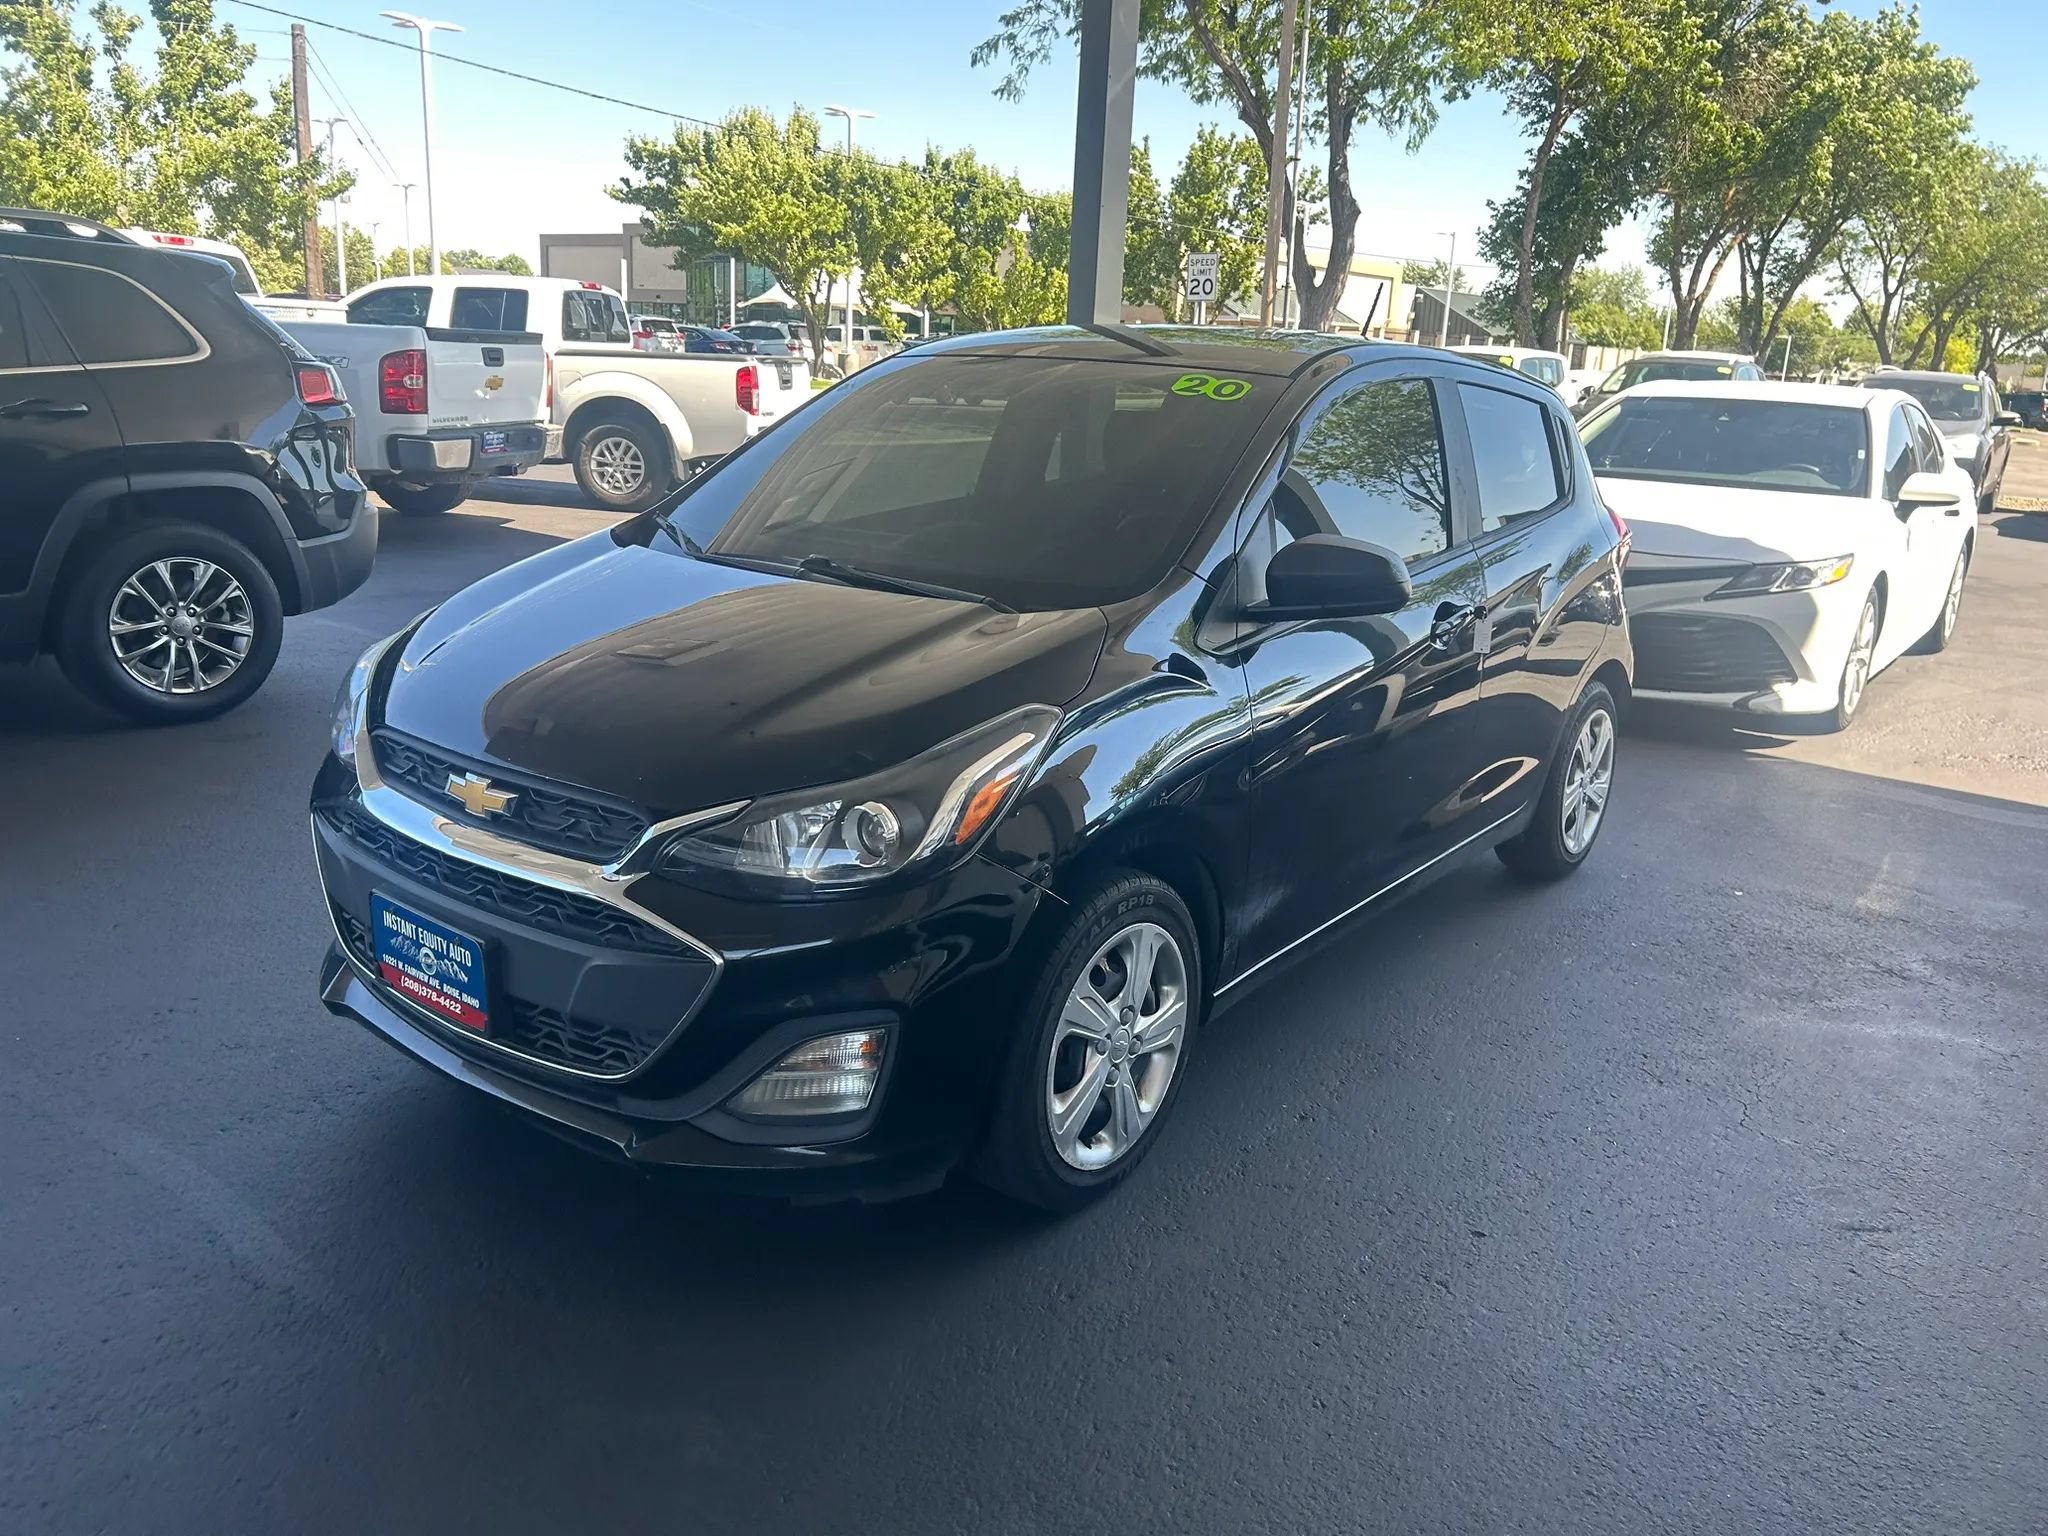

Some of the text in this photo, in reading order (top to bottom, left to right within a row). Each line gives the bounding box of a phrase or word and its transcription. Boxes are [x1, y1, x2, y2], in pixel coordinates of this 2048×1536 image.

[1190, 258, 1216, 267] SPEED
[1192, 268, 1212, 276] LIMIT
[1189, 278, 1214, 295] 20
[1173, 375, 1248, 399] 20
[1117, 894, 1155, 915] RP18
[383, 910, 472, 967] INSTANT EQUITY AUTO
[401, 975, 462, 1014] (208)378-4422
[404, 963, 429, 981] FAIRVIEW
[461, 992, 480, 1009] IDAHO
